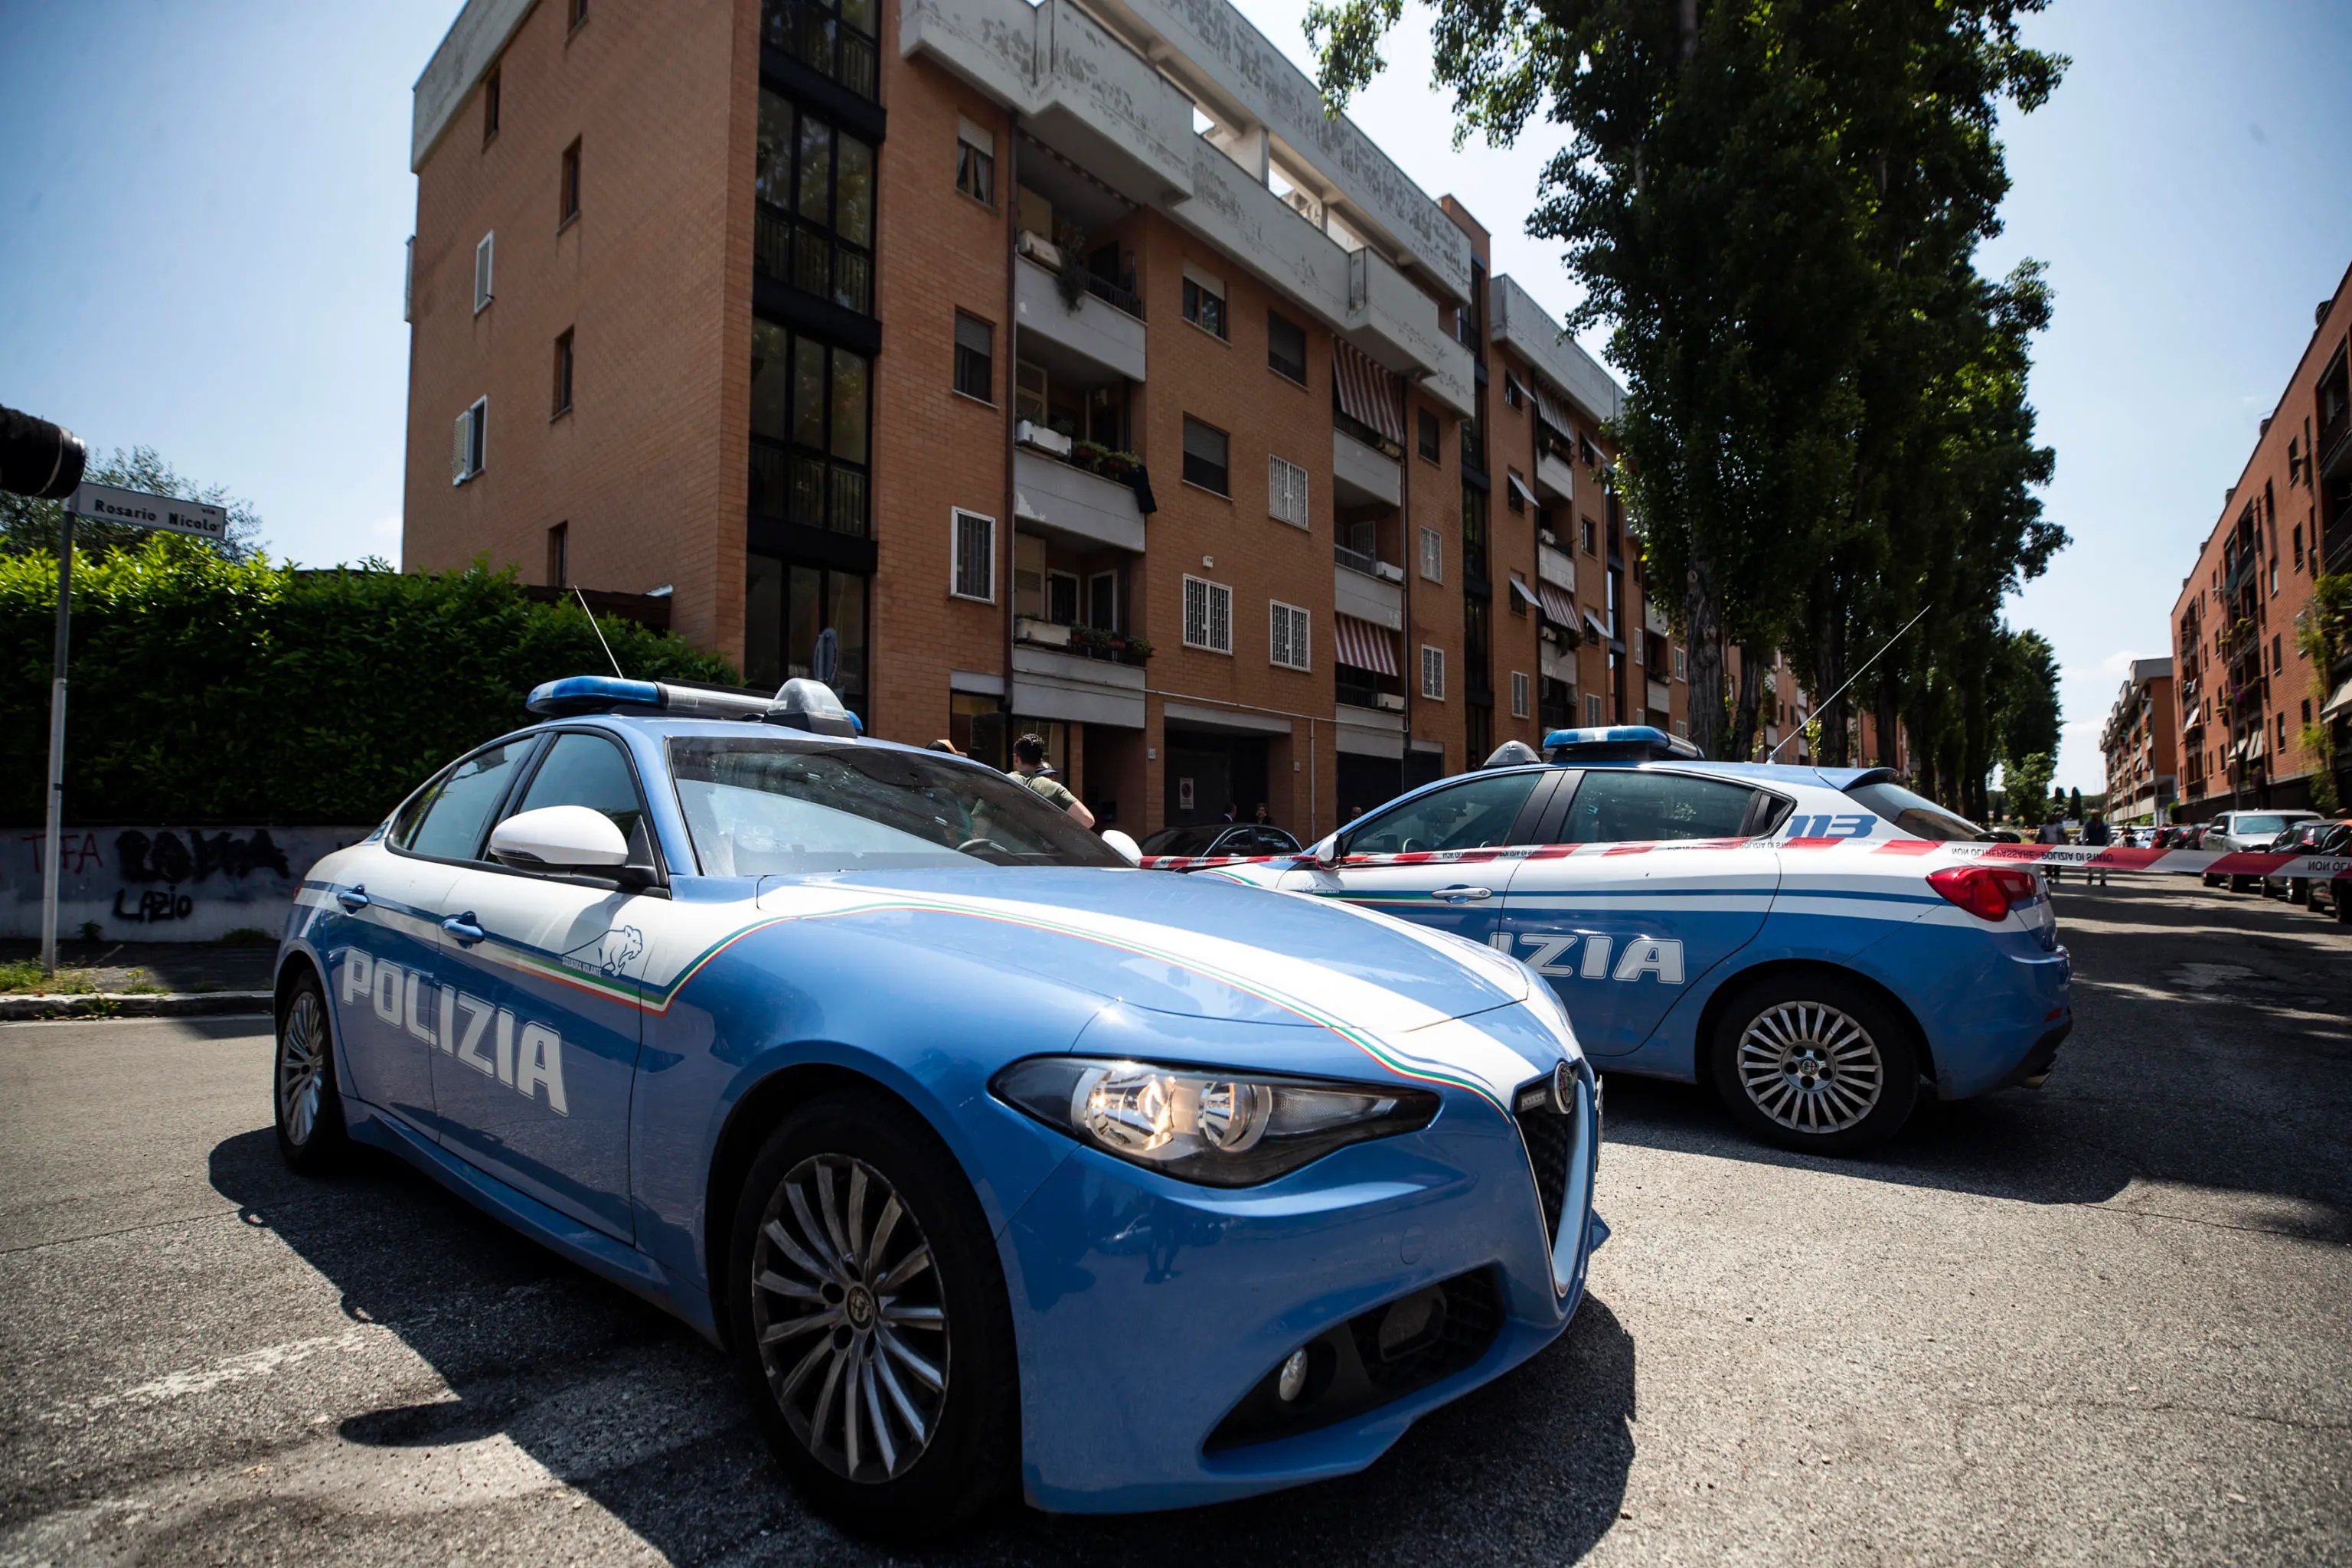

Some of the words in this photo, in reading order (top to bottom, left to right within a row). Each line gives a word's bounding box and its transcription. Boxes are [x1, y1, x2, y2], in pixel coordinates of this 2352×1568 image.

[94, 499, 157, 521] Rosario
[1785, 815, 1878, 838] 113
[21, 832, 103, 874] TFA
[342, 946, 568, 1116] POLIZIA
